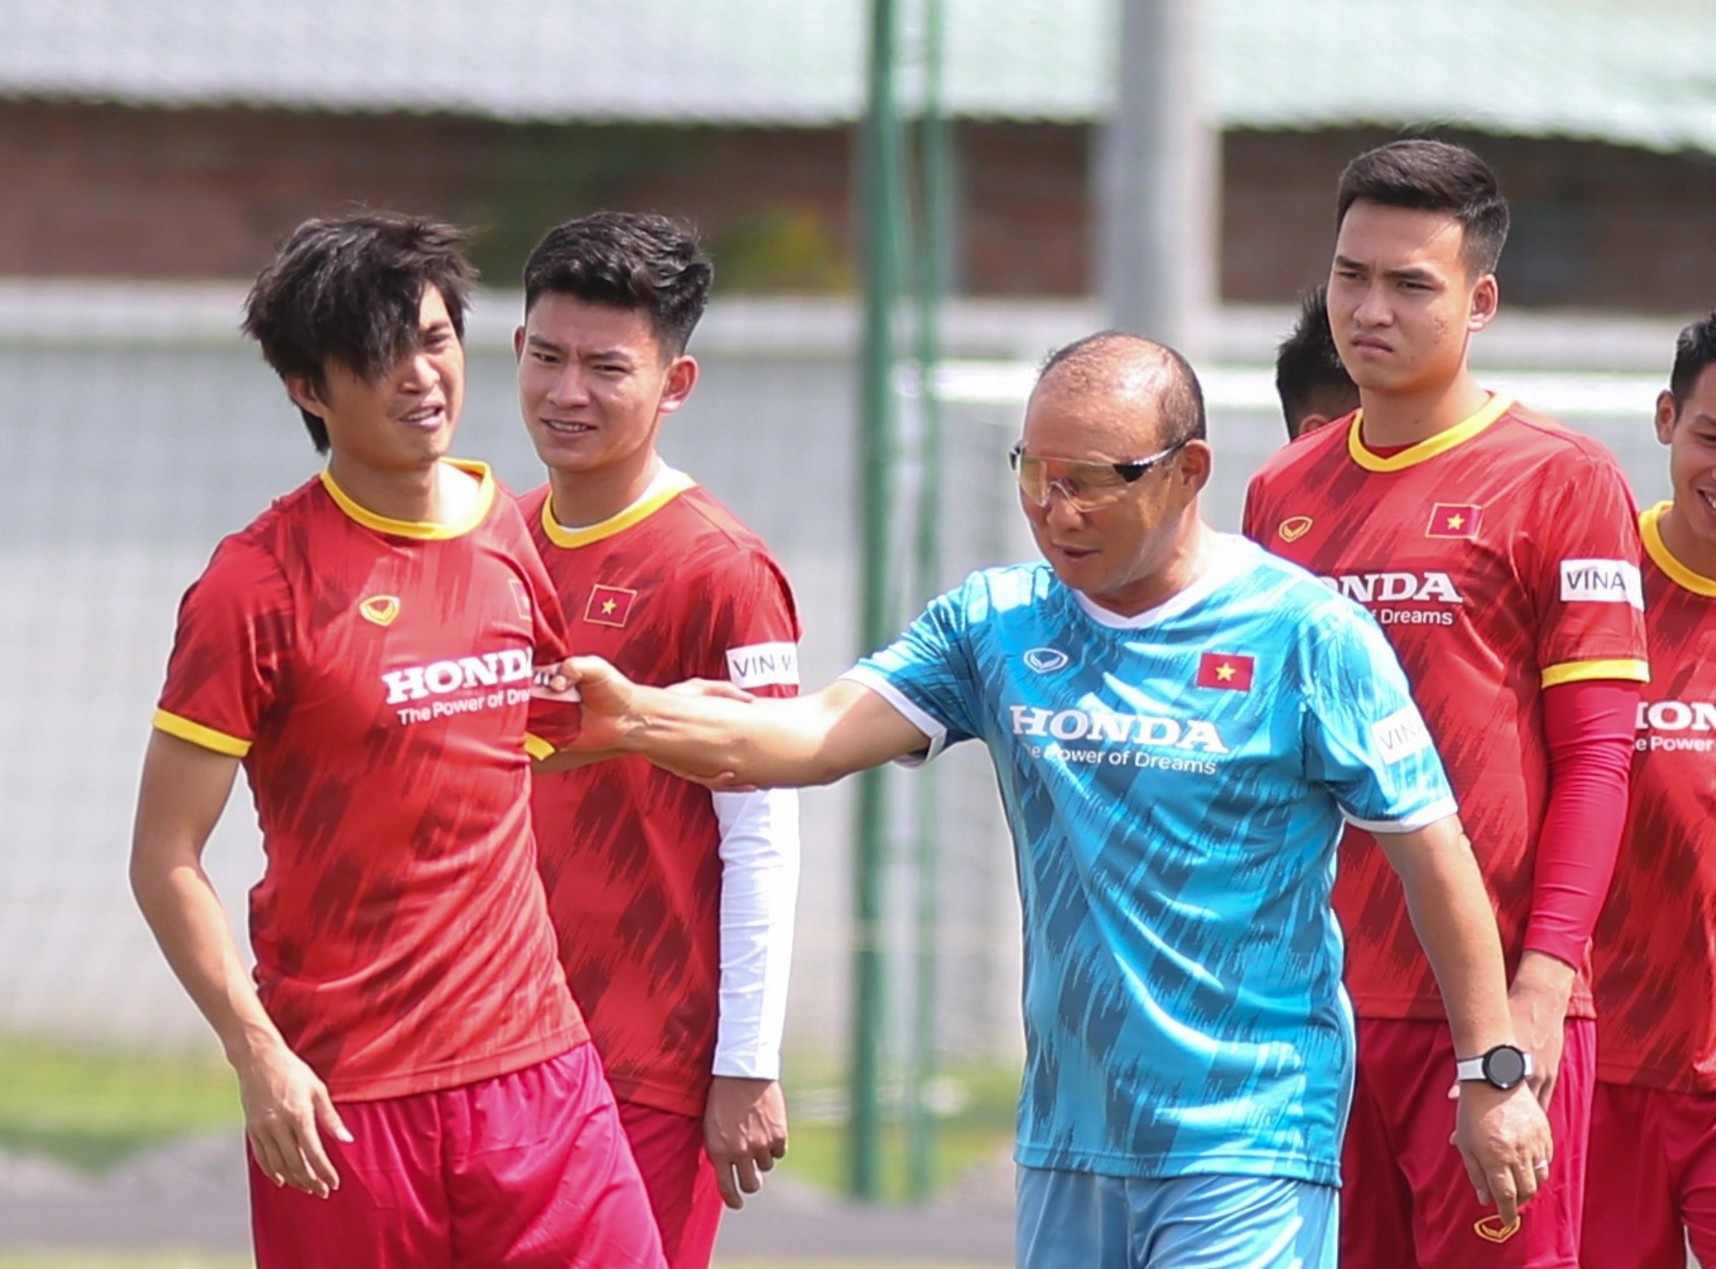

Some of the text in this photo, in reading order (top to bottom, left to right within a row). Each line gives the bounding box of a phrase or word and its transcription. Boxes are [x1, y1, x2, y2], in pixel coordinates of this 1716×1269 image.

[1380, 608, 1454, 625] Dreams
[382, 646, 532, 705] HOND
[397, 706, 431, 725] The
[433, 696, 485, 718] Power
[487, 690, 504, 708] of
[1009, 704, 1229, 753] HONDA
[1650, 735, 1715, 752] Power
[1108, 752, 1130, 766] of
[1134, 752, 1217, 775] Dreams
